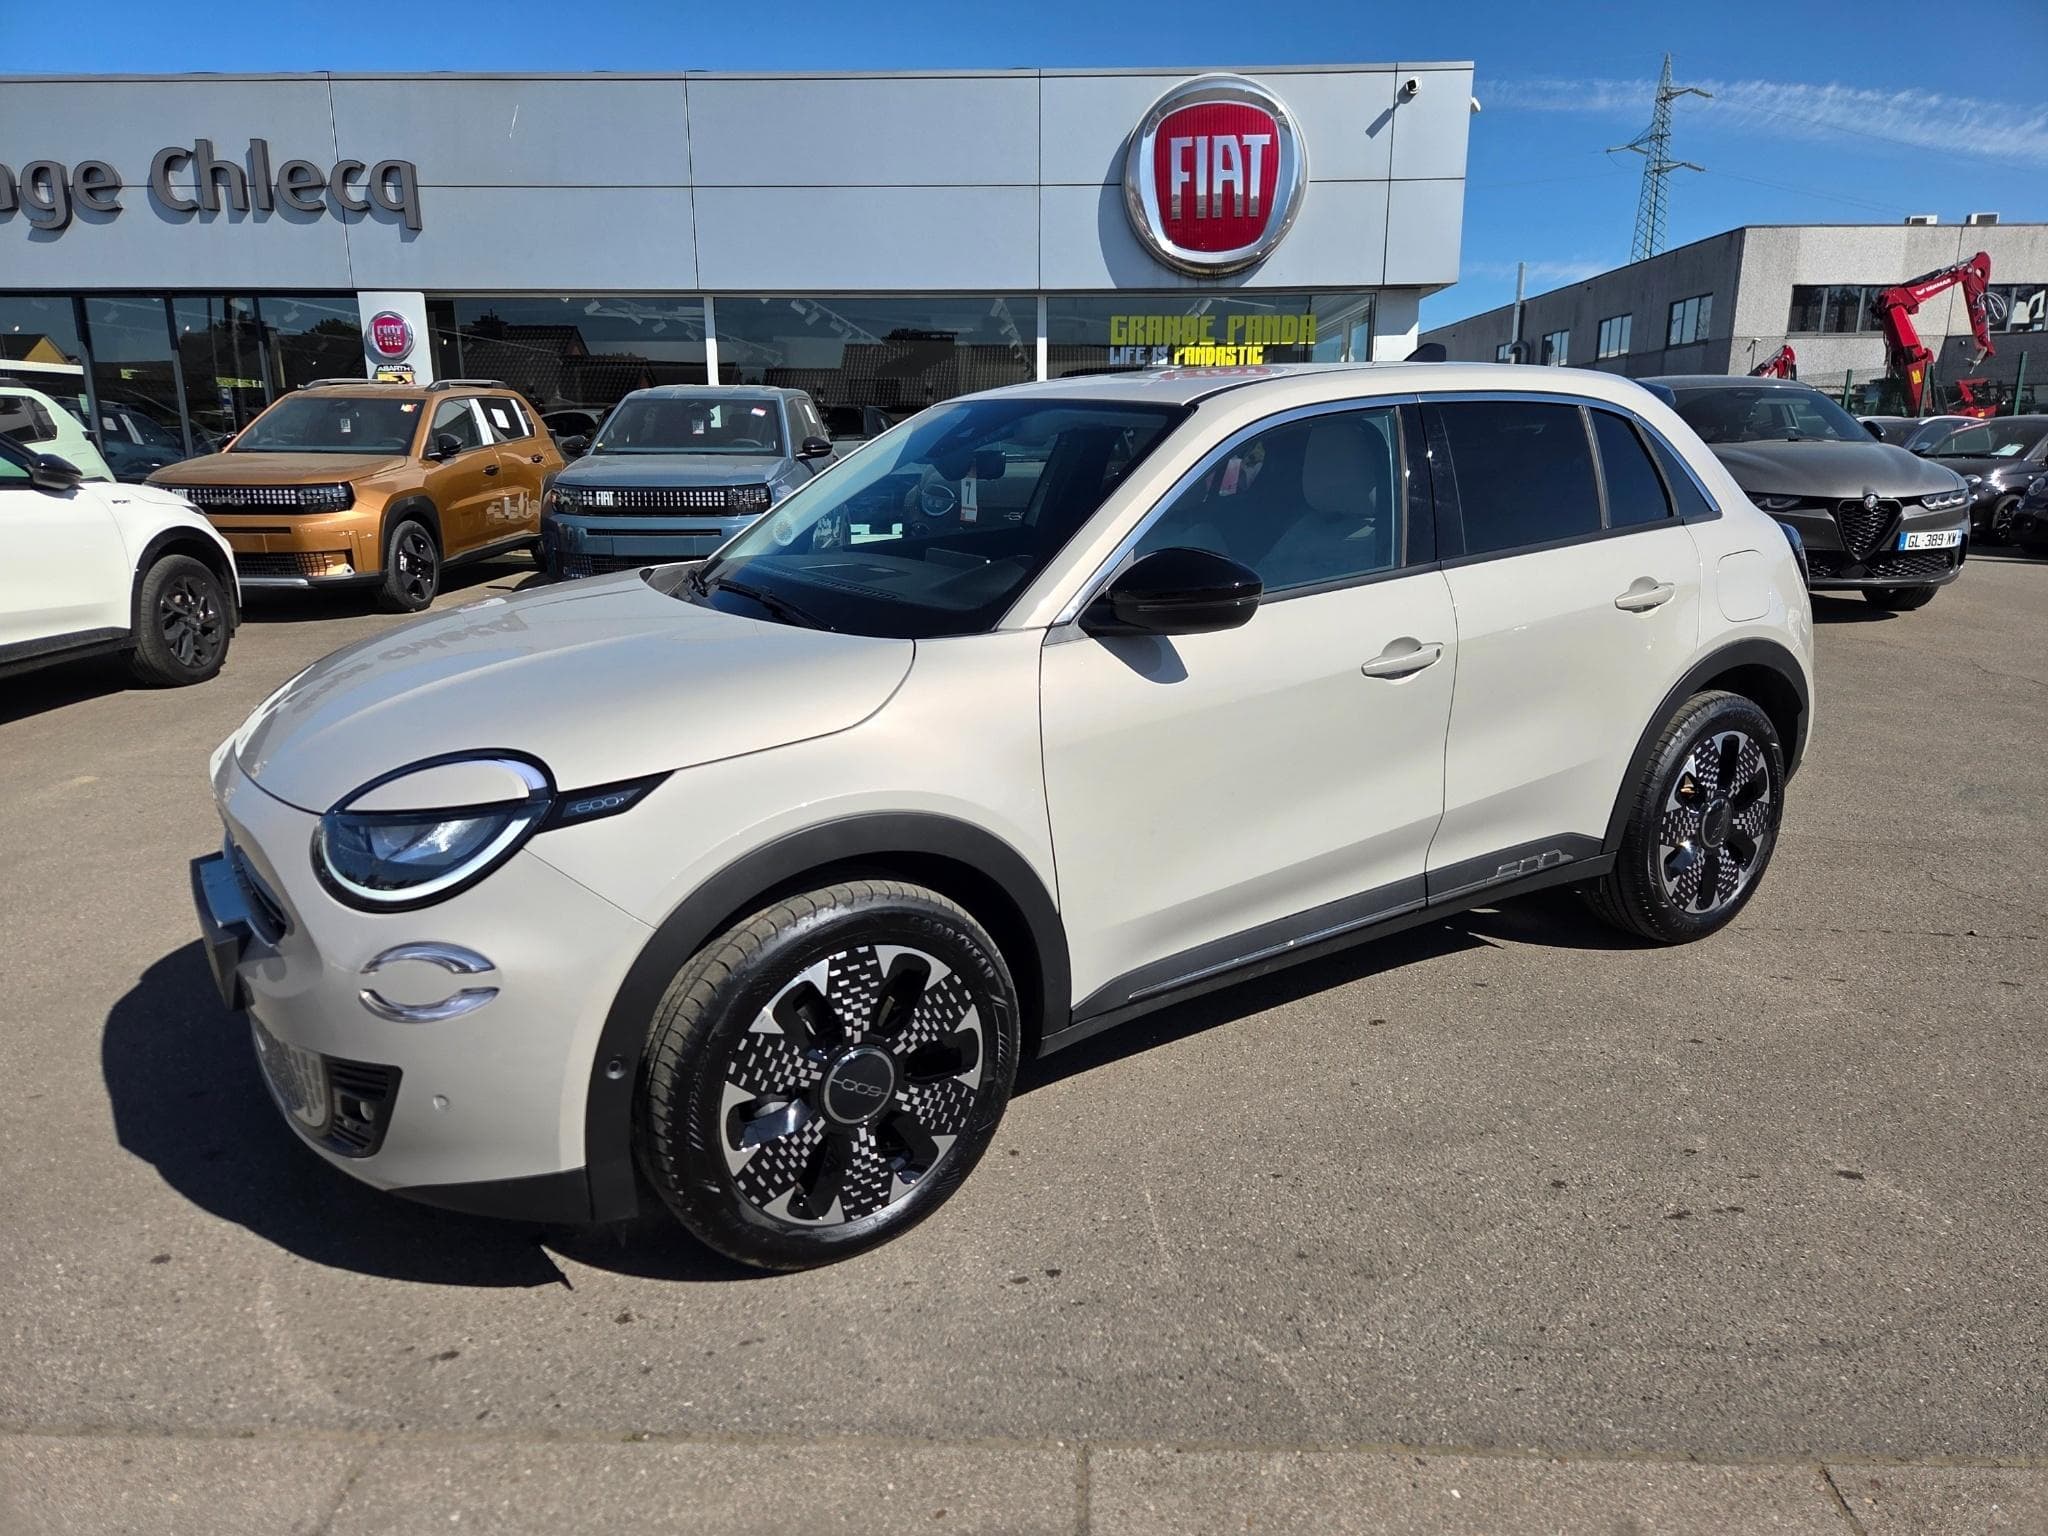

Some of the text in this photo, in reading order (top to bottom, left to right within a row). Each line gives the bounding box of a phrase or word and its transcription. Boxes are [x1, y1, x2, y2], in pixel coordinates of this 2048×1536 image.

[0, 138, 422, 231] ge Chlecq
[1170, 133, 1271, 219] FIAT
[1110, 314, 1316, 345] GRANDE PANDA
[1109, 345, 1264, 367] LIFE IS PANDASTIC
[596, 491, 614, 506] FIAT
